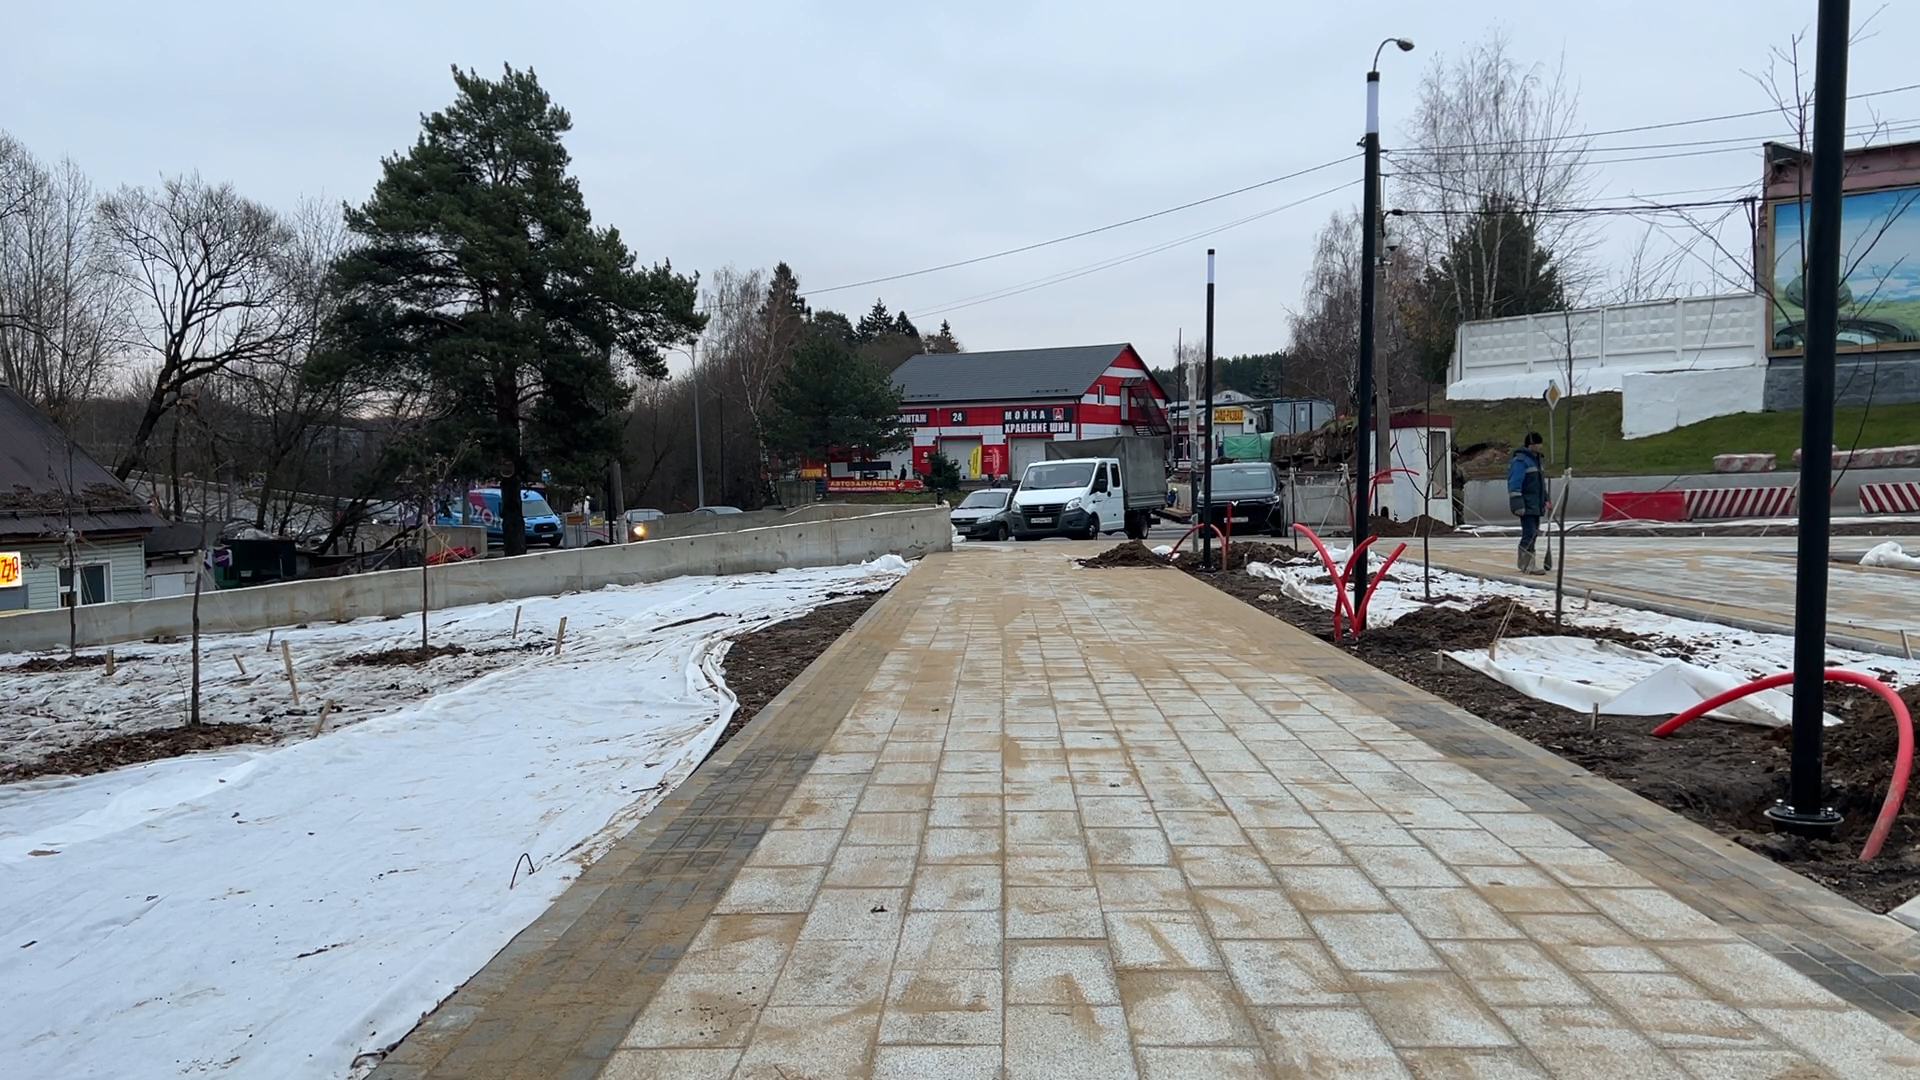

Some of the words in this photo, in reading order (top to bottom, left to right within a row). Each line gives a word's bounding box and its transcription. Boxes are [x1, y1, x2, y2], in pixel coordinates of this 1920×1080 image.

[952, 412, 963, 422] 24
[1004, 409, 1046, 421] МОЙКА
[1004, 422, 1048, 433] ХРАНЕНИЕ
[1049, 422, 1070, 433] ШИН
